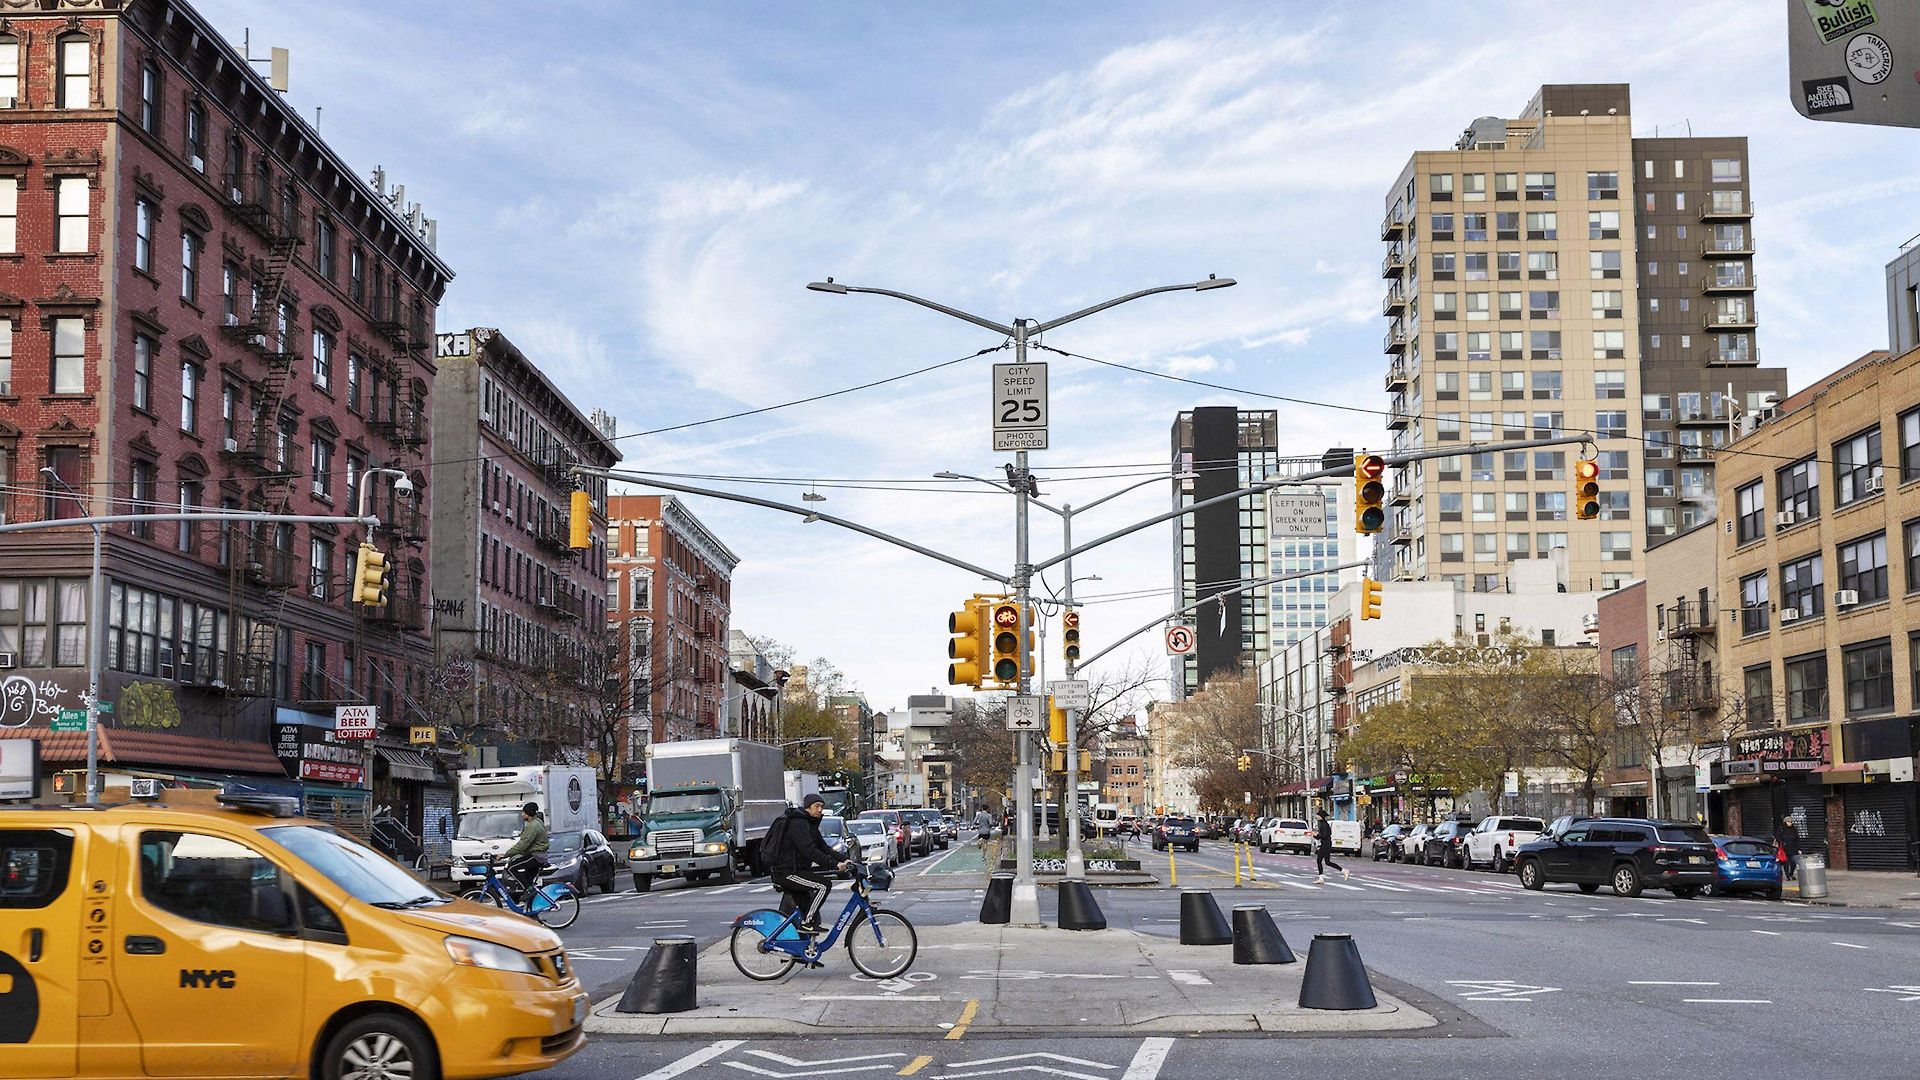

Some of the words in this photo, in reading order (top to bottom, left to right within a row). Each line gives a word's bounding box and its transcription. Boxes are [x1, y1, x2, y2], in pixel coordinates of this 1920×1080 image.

[1817, 2, 1872, 33] Bullish
[1854, 17, 1873, 29] MONEY
[1867, 36, 1890, 82] TANKCRIMES
[1816, 85, 1833, 94] SXE
[1808, 93, 1834, 102] ANTIFA
[1004, 377, 1035, 386] SPEED
[1007, 388, 1032, 396] LIMIT
[1001, 399, 1041, 423] 25
[998, 440, 1043, 448] ENFORCED
[61, 711, 79, 720] Allen
[342, 708, 370, 717] ATM
[341, 718, 367, 727] BEER
[281, 734, 295, 742] BEER
[337, 729, 373, 738] LOTTERY
[414, 731, 431, 739] PIE
[277, 750, 298, 758] SNACKS
[180, 969, 236, 989] NYC
